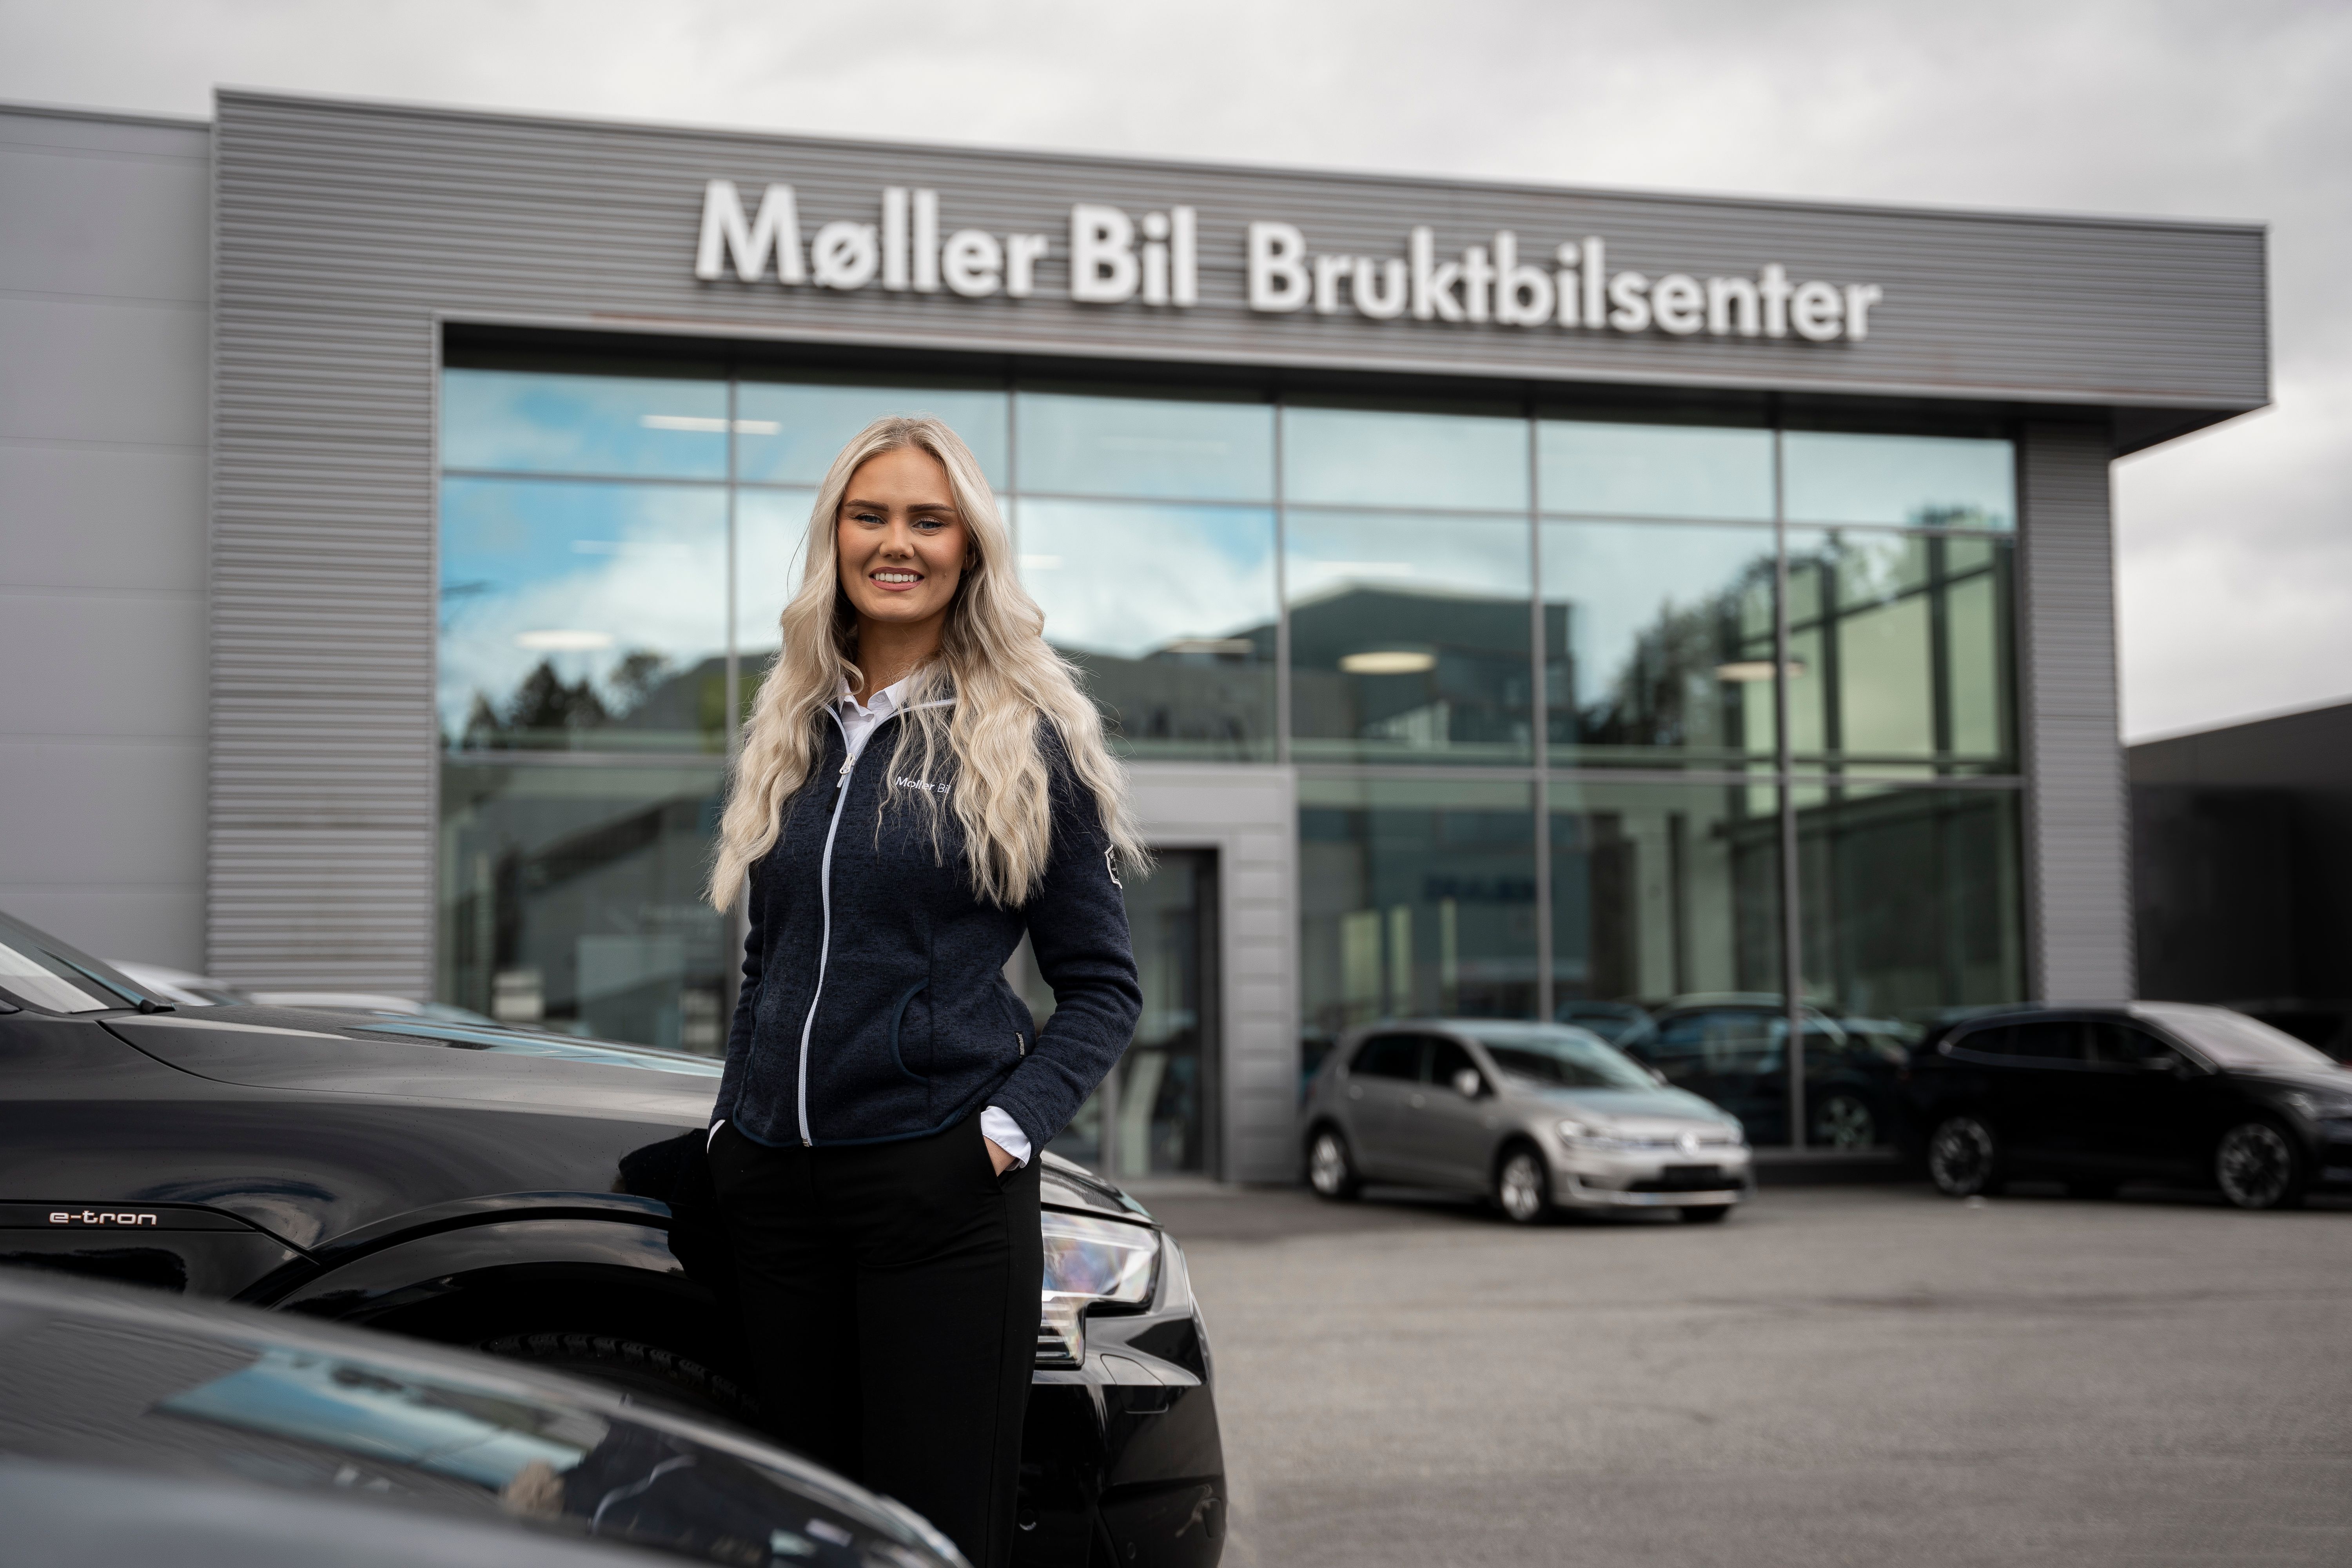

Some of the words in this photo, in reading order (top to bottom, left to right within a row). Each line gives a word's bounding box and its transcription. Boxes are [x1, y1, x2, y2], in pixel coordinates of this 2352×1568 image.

[696, 179, 1047, 298] Møller
[1071, 202, 1198, 307] Bil
[1247, 220, 1882, 341] Bruktbilsenter
[49, 1210, 157, 1226] e-tron
